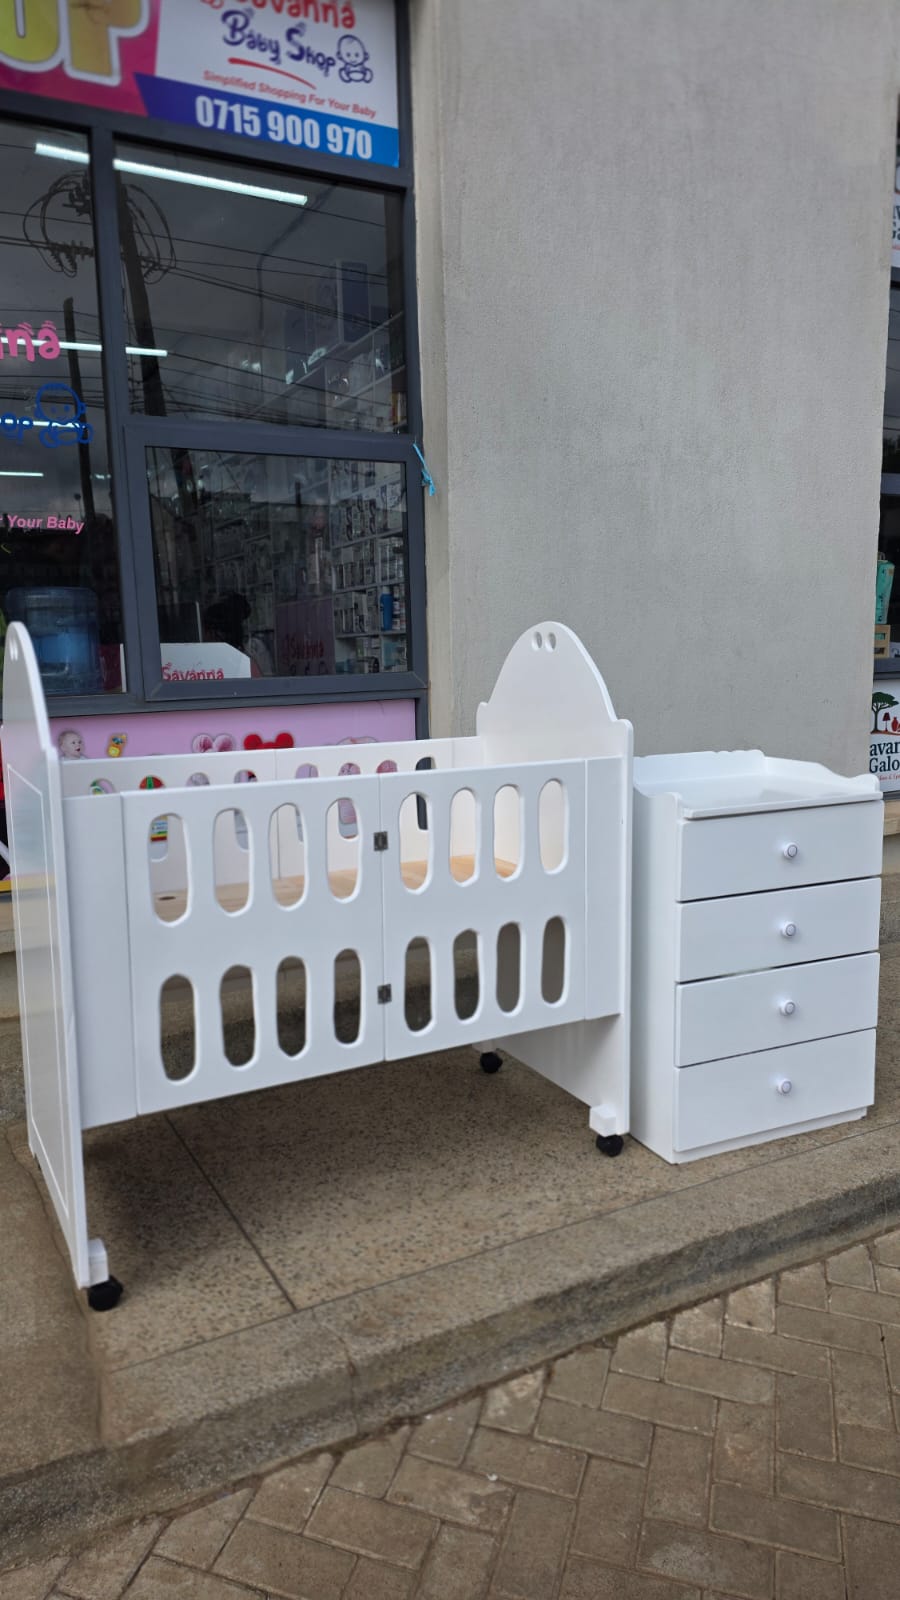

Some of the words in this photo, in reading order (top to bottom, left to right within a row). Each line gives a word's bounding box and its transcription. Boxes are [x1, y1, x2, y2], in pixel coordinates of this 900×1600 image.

[237, 0, 356, 29] vanna
[221, 9, 281, 64] Baby
[286, 24, 336, 77] Shop
[203, 70, 256, 90] Simplified
[258, 82, 307, 103] Shopping
[308, 94, 325, 106] For
[328, 98, 350, 111] Your
[352, 103, 377, 119] Baby
[195, 95, 261, 137] 0715
[266, 110, 320, 149] 900
[326, 123, 373, 160] 970
[0, 320, 61, 363] na
[7, 515, 43, 529] Your
[46, 516, 85, 534] Baby
[161, 662, 225, 681] Savanna
